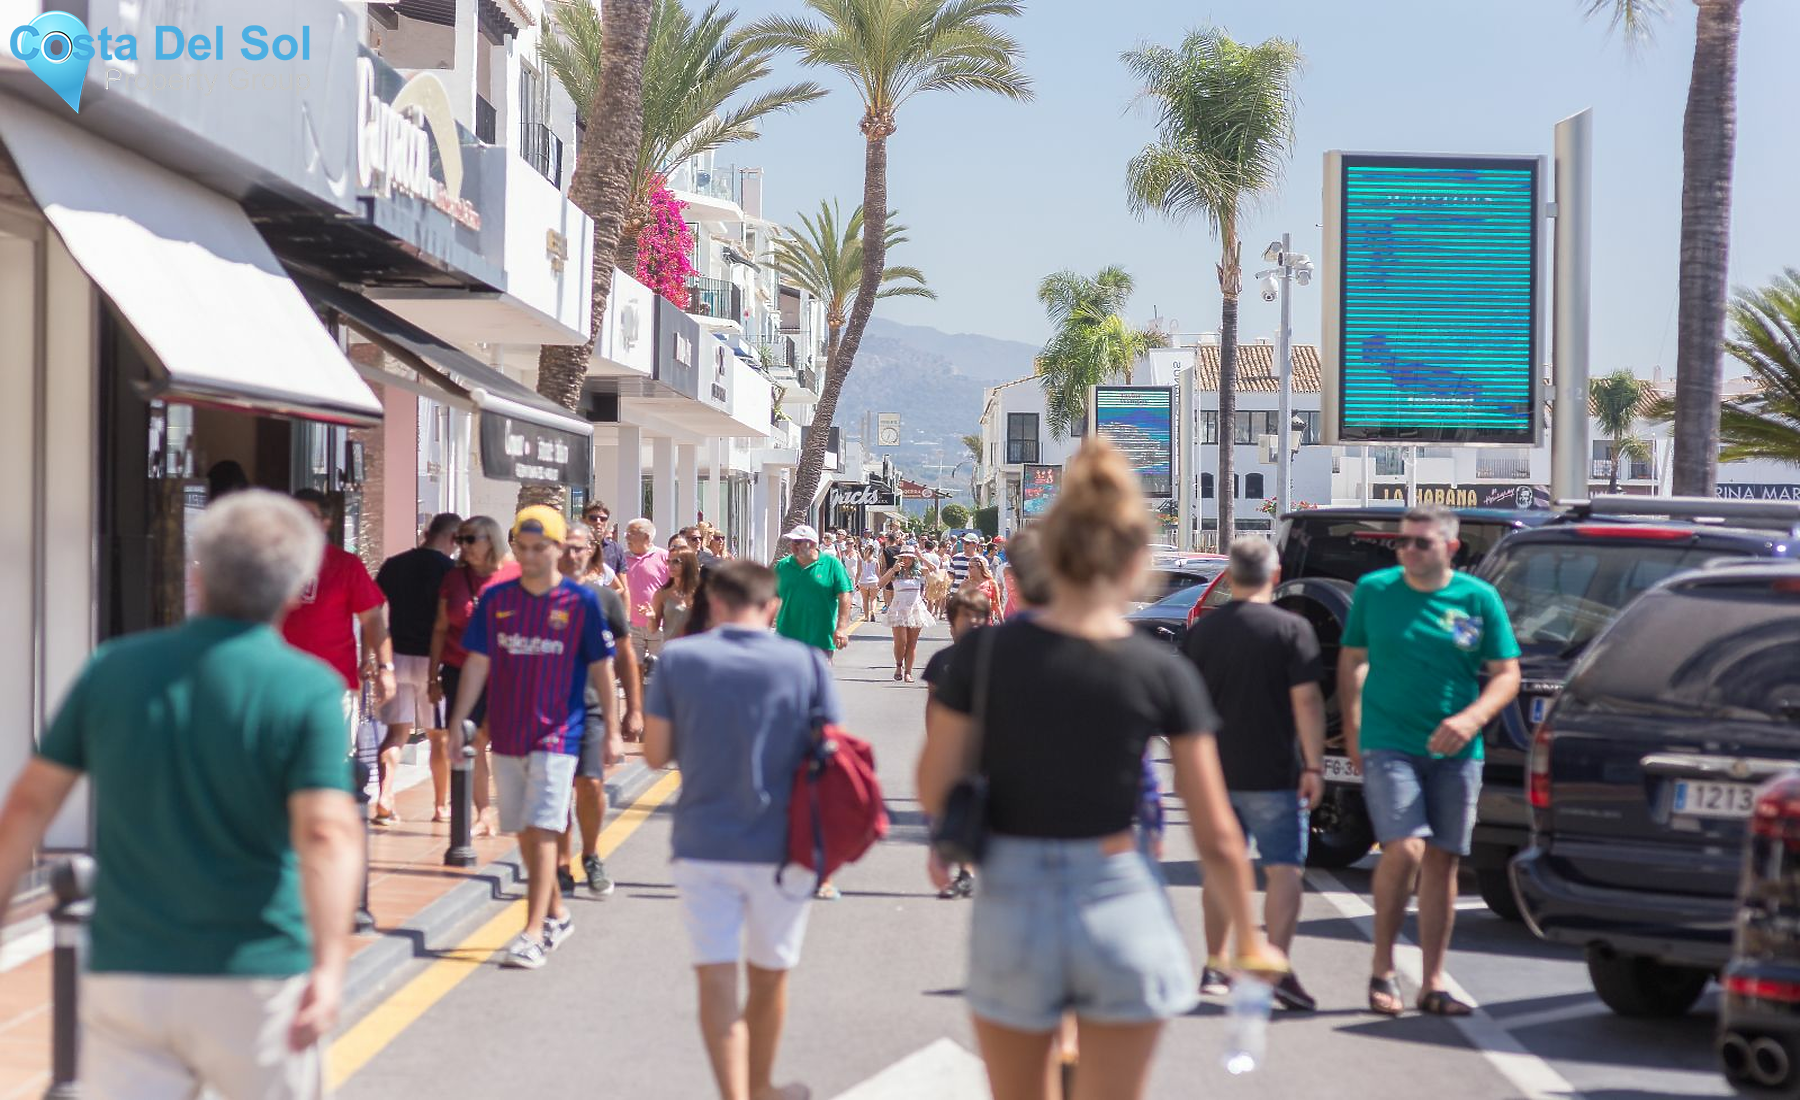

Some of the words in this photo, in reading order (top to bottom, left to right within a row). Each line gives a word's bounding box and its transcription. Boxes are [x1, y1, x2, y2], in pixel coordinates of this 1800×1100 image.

[1416, 488, 1478, 506] HABANA
[1715, 486, 1755, 500] RINA
[1762, 486, 1800, 501] MAR
[1696, 785, 1754, 811] 1213
